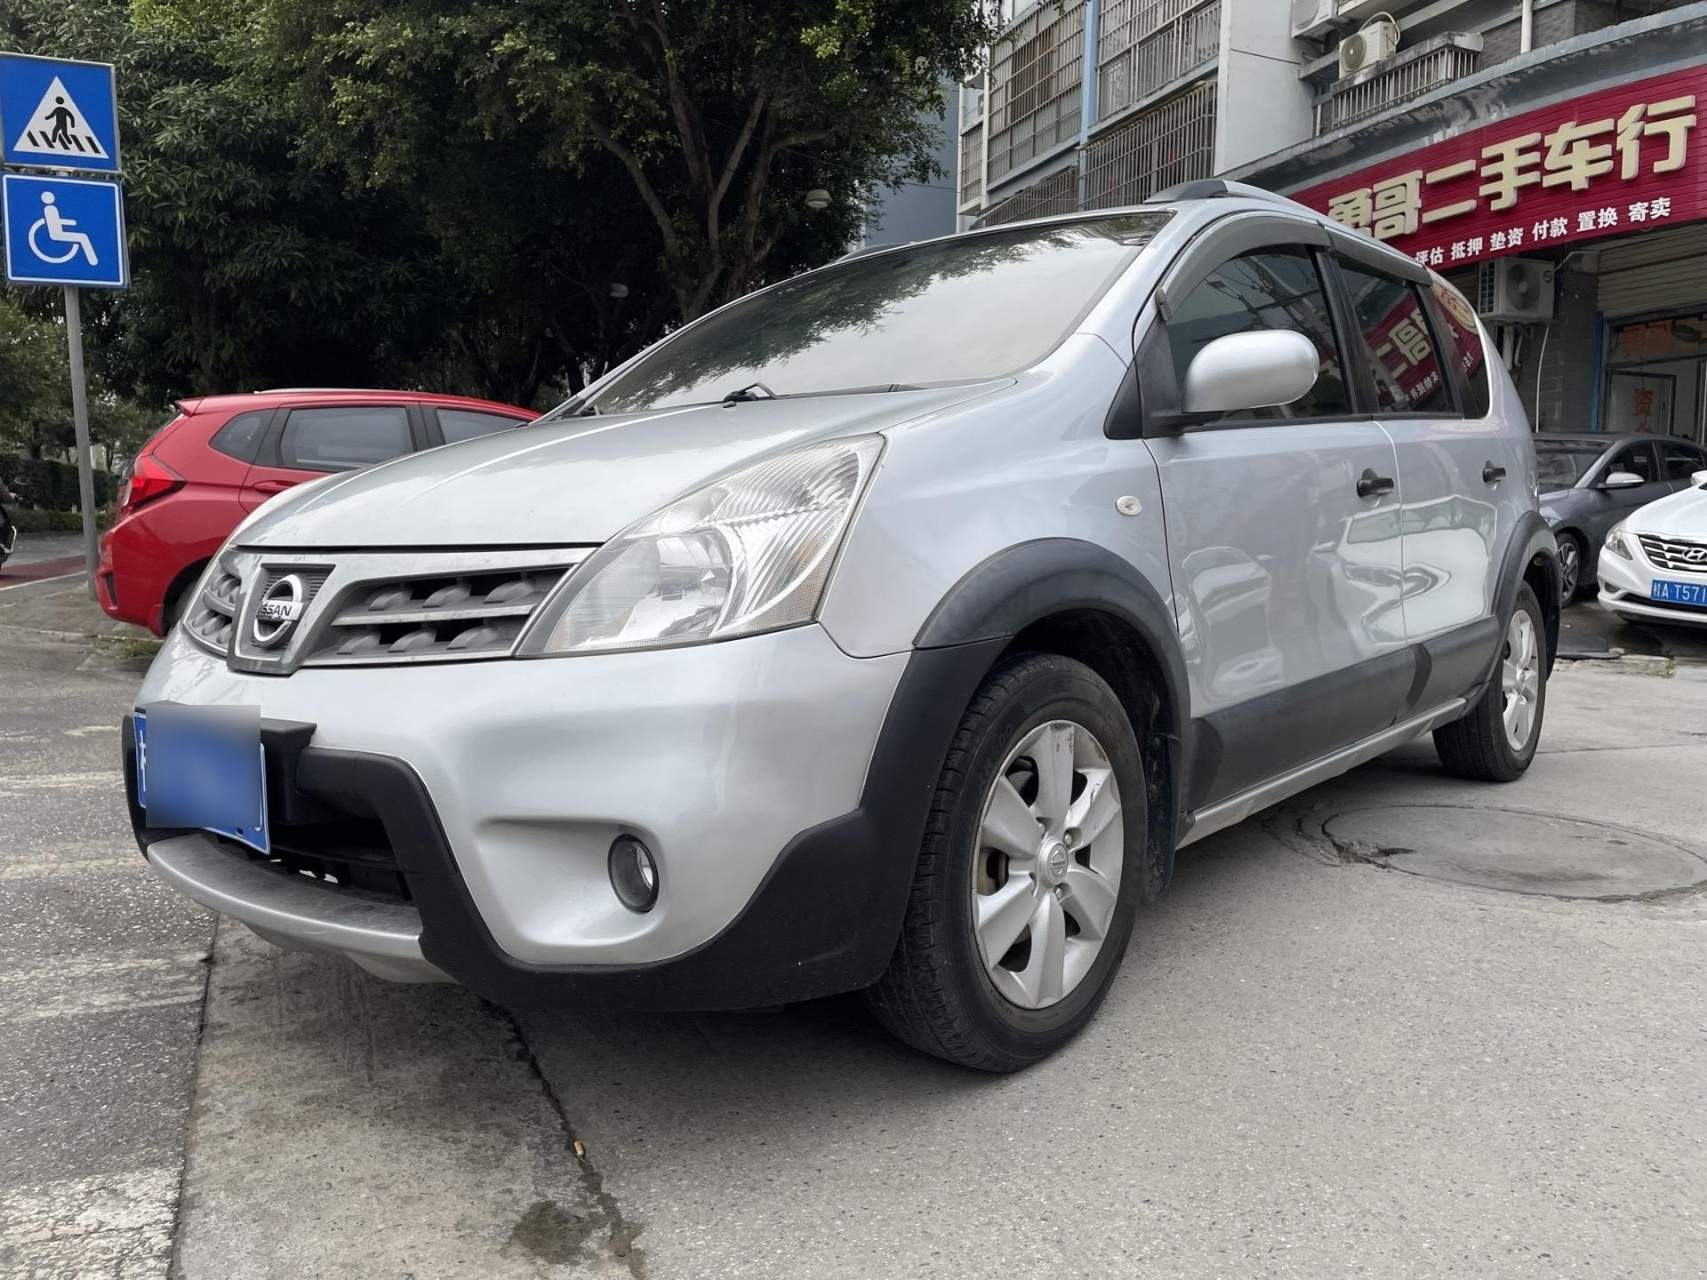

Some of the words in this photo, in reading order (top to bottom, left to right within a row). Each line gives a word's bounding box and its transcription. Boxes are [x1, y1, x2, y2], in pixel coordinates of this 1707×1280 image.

[1451, 237, 1483, 260] 抵押
[1490, 228, 1524, 252] 垫资
[1532, 217, 1568, 241] 付款
[1577, 207, 1618, 232] 置换
[1628, 197, 1671, 222] 寄卖
